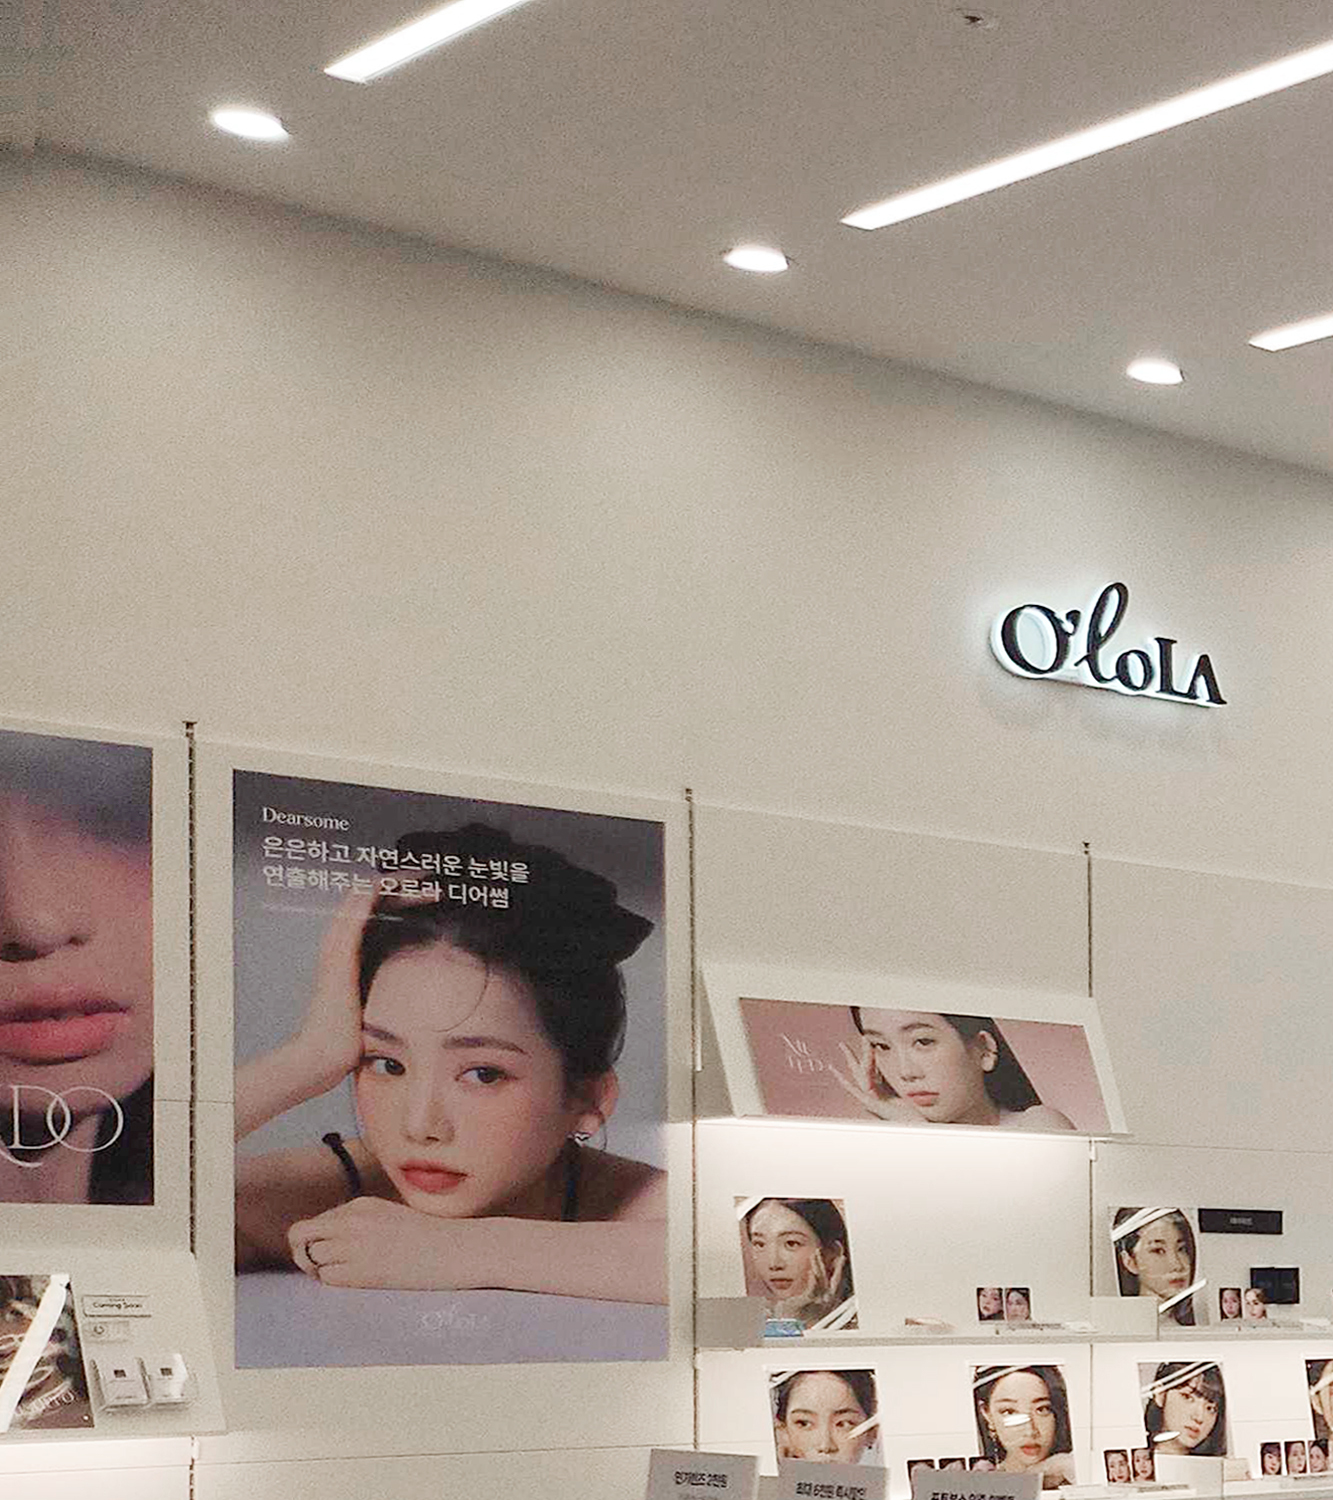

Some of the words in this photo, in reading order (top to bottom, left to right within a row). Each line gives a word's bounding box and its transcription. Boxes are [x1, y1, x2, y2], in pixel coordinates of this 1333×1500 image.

[262, 806, 350, 831] Dearsome
[262, 835, 350, 864] 은은하고
[357, 846, 463, 877] 자연스러운
[468, 857, 530, 884] 눈빛을
[262, 864, 373, 895] 연출해주는
[378, 878, 443, 903] 오로라
[448, 883, 510, 909] 디어썸
[0, 1086, 124, 1167] DO
